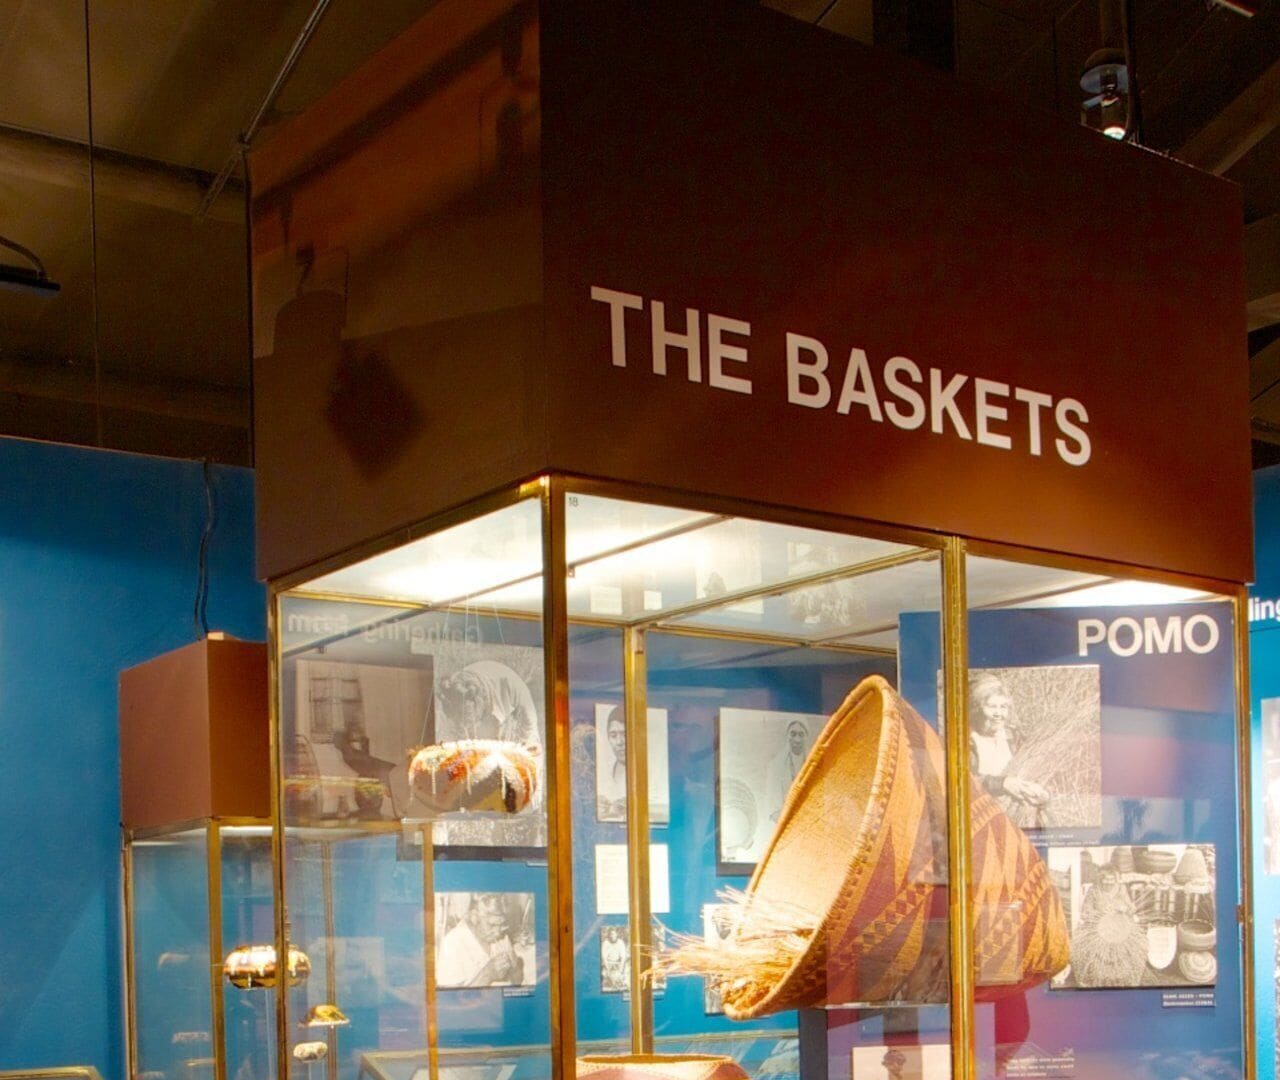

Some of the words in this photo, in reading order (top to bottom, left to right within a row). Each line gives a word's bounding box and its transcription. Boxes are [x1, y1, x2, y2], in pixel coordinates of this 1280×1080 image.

[591, 287, 752, 395] THE
[787, 332, 1092, 466] BASKETS
[1078, 614, 1219, 657] POMO
